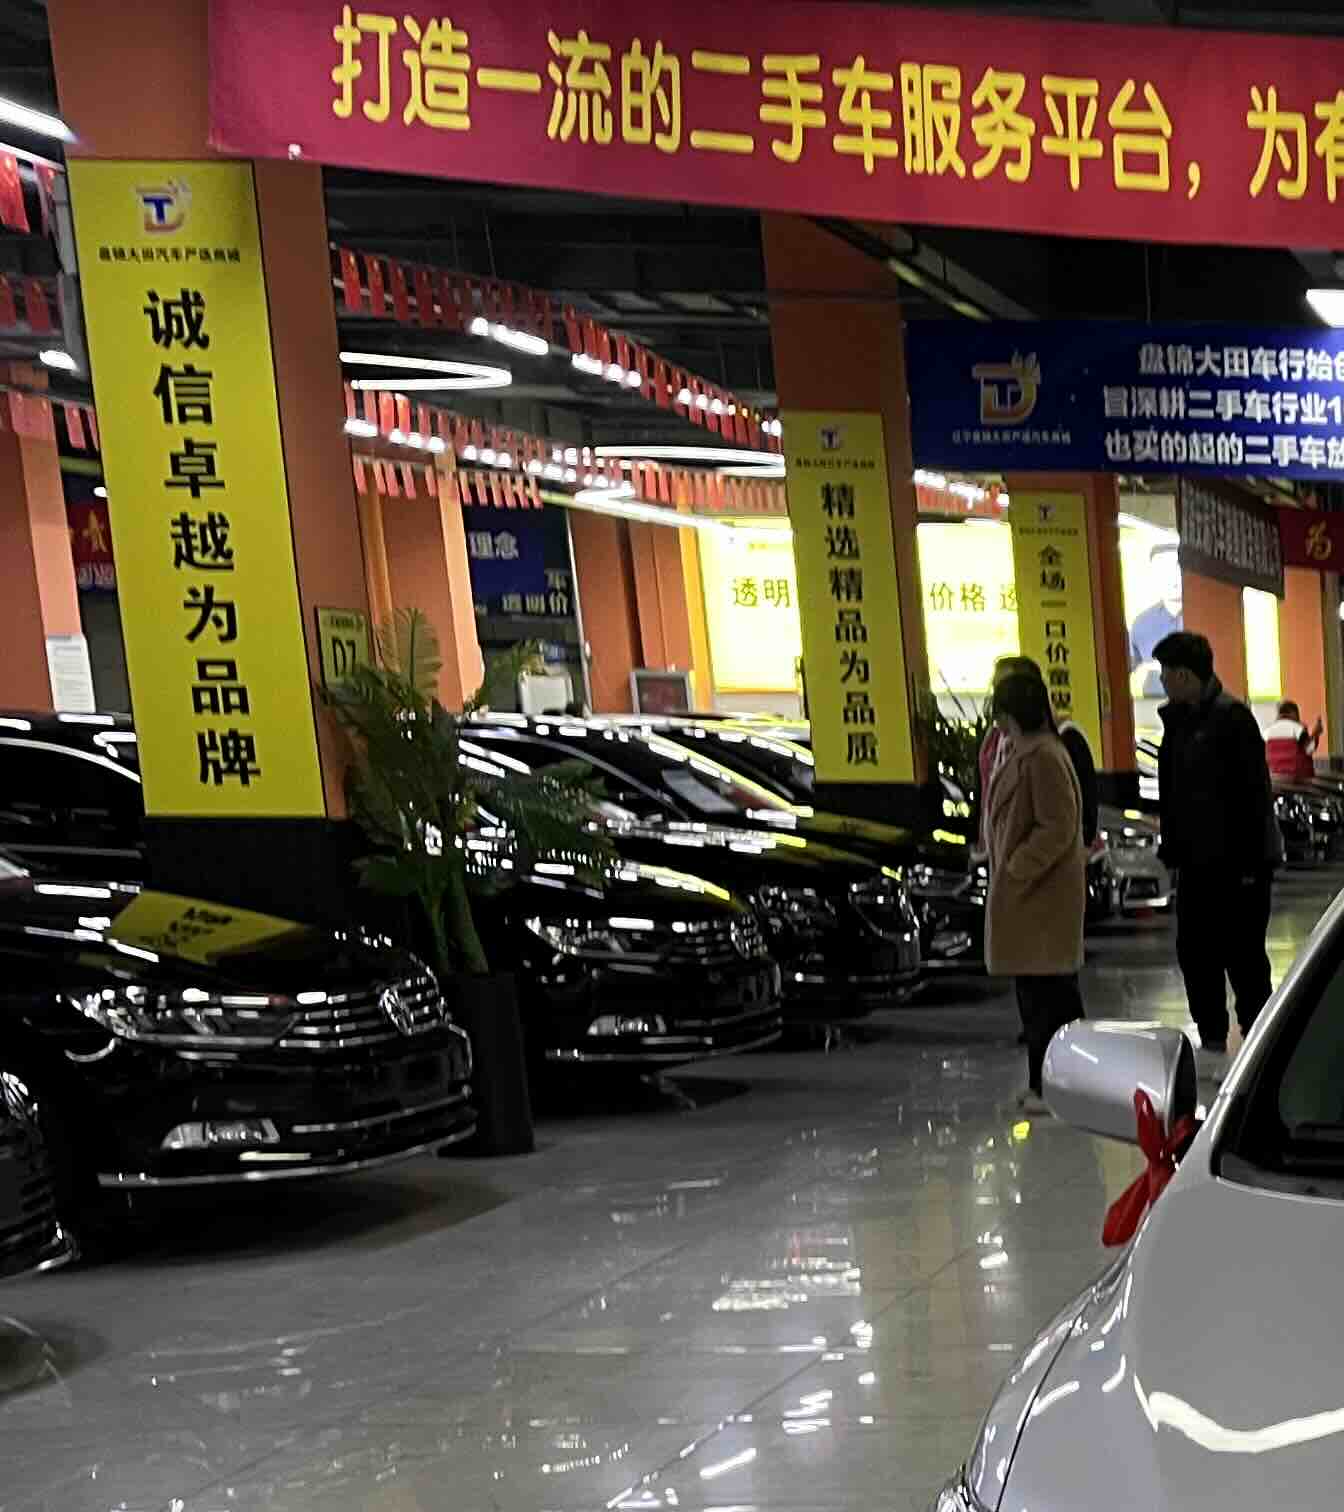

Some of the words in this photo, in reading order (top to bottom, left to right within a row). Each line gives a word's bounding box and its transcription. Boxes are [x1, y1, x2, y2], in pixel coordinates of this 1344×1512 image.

[144, 287, 262, 787] 诚信卓越为品牌
[731, 577, 791, 608] 透明
[929, 582, 986, 612] 价格
[821, 481, 878, 767] 精选精品为品质
